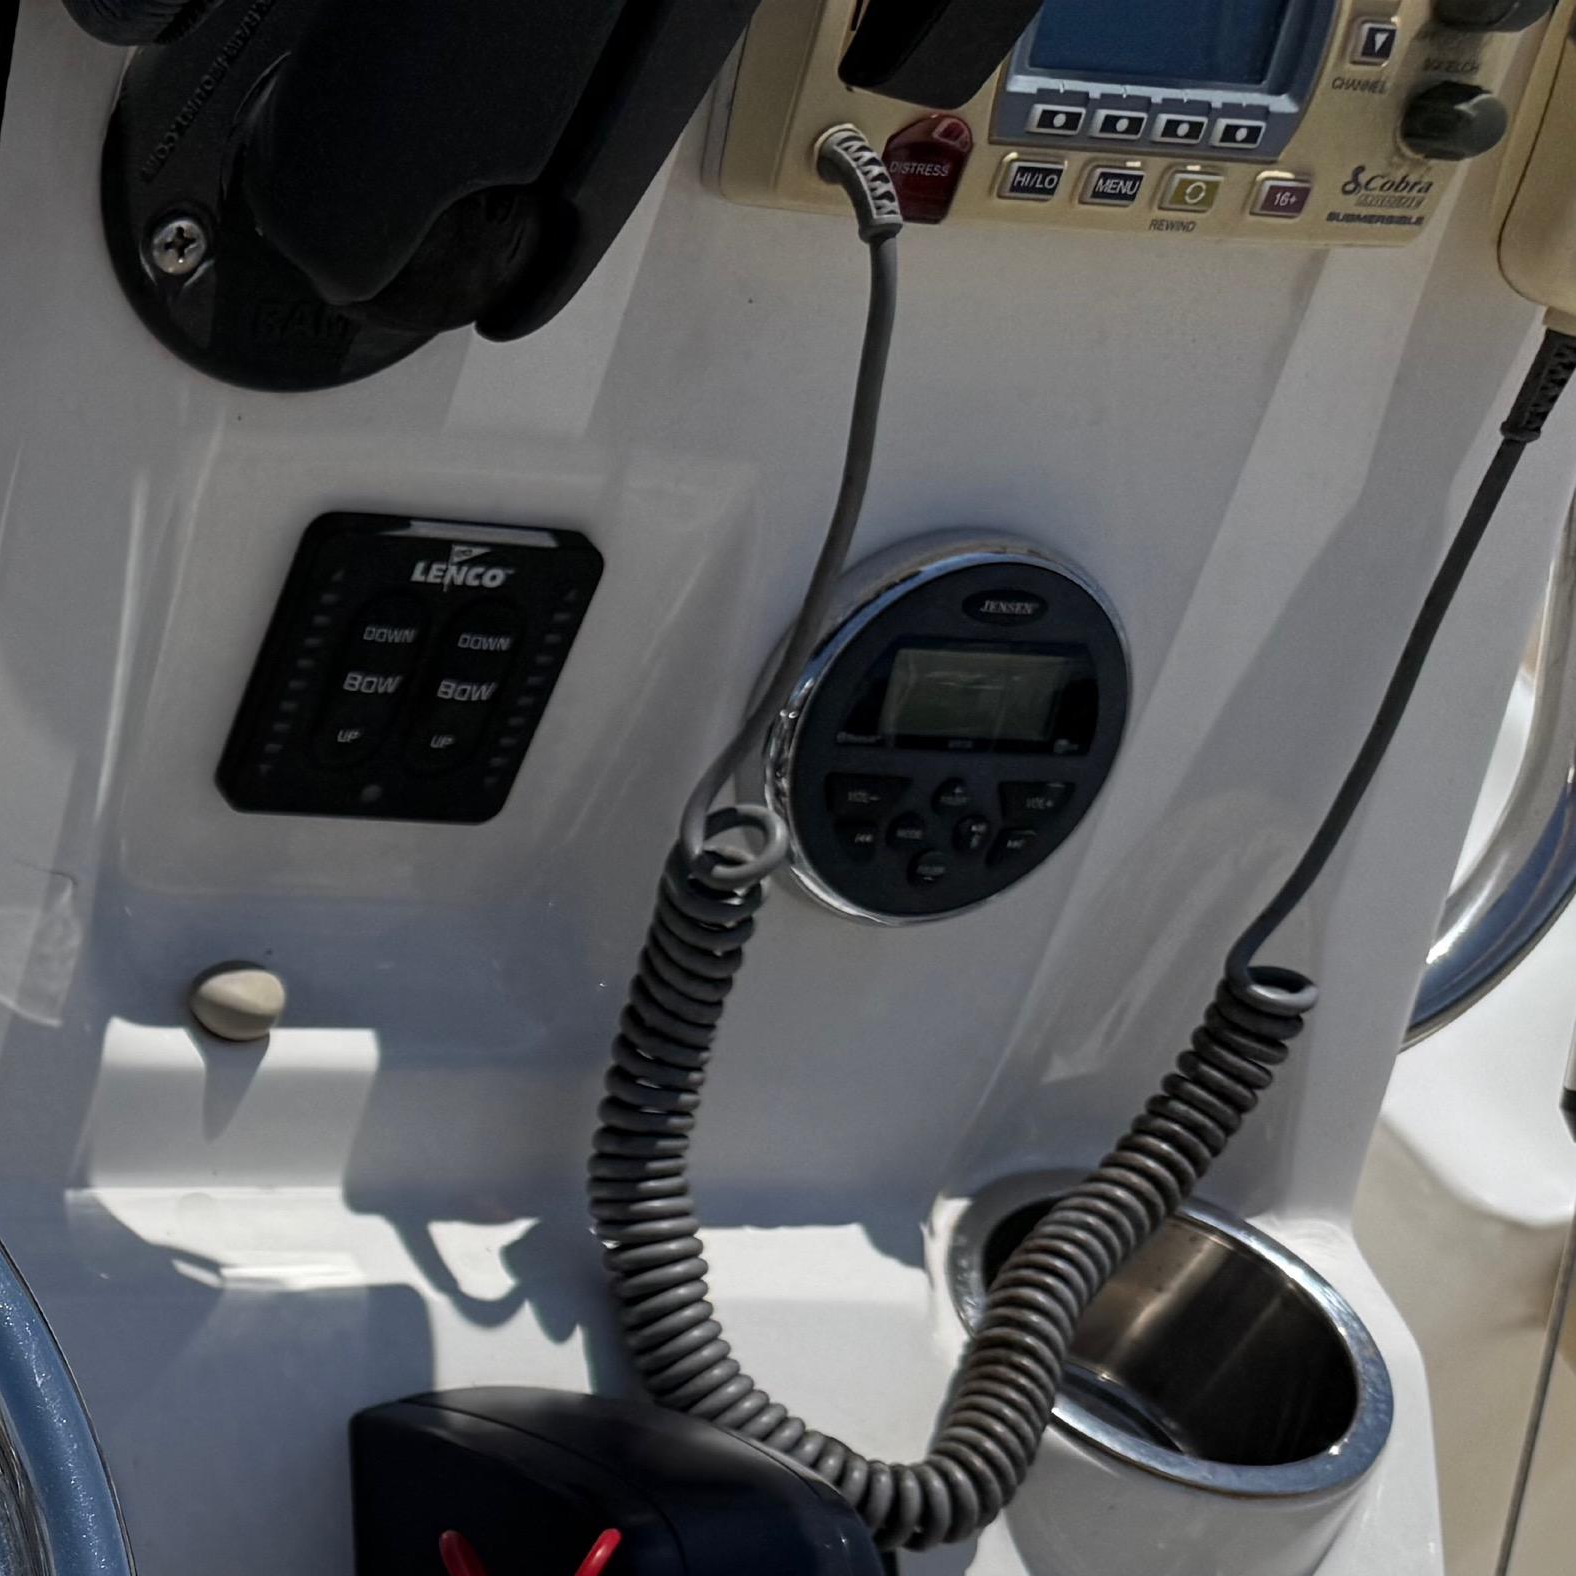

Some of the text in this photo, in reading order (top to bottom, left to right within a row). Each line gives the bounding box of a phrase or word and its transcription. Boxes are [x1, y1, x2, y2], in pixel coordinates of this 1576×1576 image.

[1332, 76, 1388, 94] CHANNEL
[889, 160, 950, 178] DISTRESS
[1013, 172, 1059, 190] HI/LO
[1095, 178, 1141, 196] MENU
[1364, 174, 1434, 194] Cobra
[1149, 219, 1196, 233] REWIND
[410, 560, 507, 590] LENCO
[980, 599, 1035, 615] JENSEN
[363, 625, 417, 644] DOWN
[457, 632, 512, 652] DOWN
[343, 672, 403, 694] BOW
[437, 679, 498, 701] BOW
[337, 729, 361, 744] UP
[430, 734, 455, 749] UP
